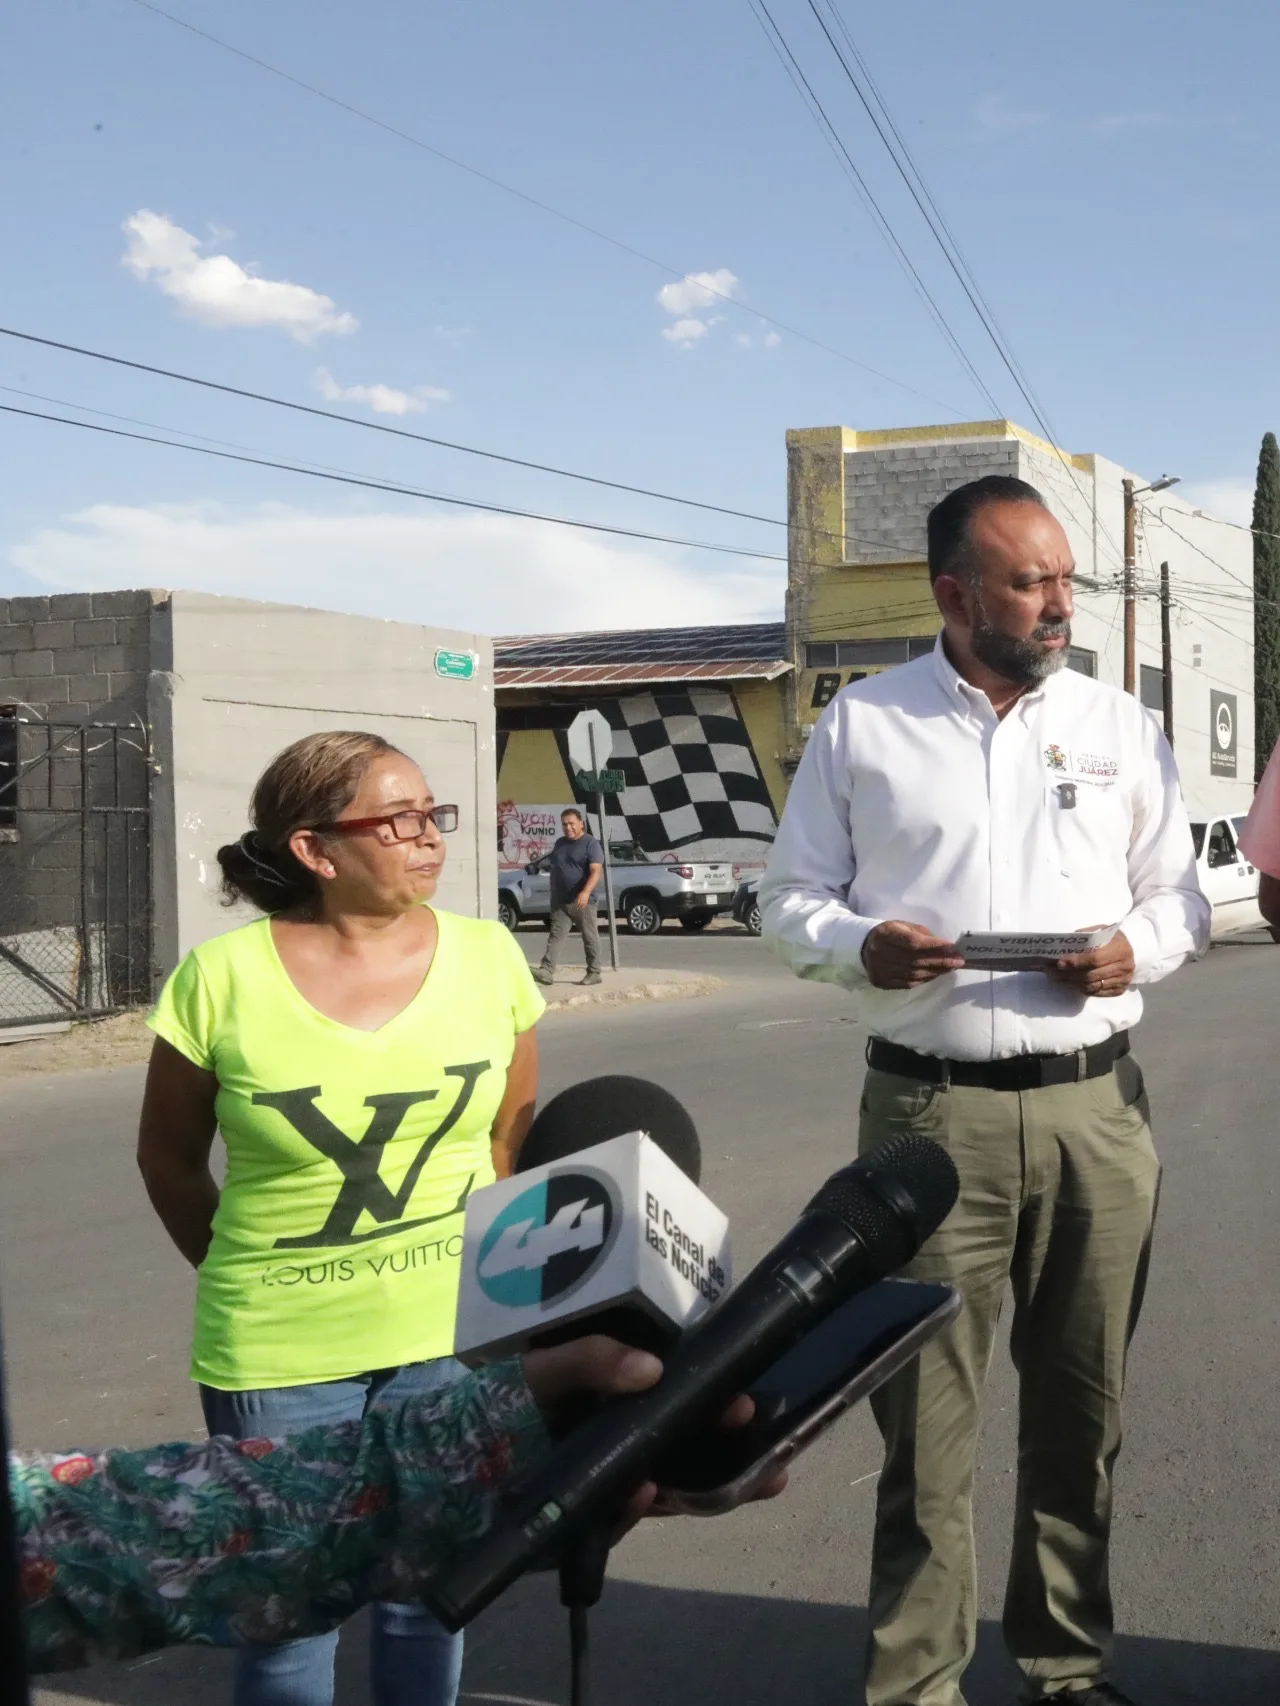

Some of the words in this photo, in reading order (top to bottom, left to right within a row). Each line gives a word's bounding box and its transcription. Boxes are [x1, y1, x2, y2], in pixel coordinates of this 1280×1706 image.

[1077, 757, 1117, 769] CIUDAD
[1078, 765, 1119, 776] JUÁREZ
[1000, 936, 1089, 945] COLOMBIA
[644, 1189, 659, 1225] El
[663, 1208, 704, 1269] Canal
[708, 1255, 725, 1288] de
[262, 1259, 356, 1287] LOUIS
[367, 1234, 465, 1277] VUITTO
[644, 1217, 668, 1260] las
[671, 1242, 721, 1303] Noticia
